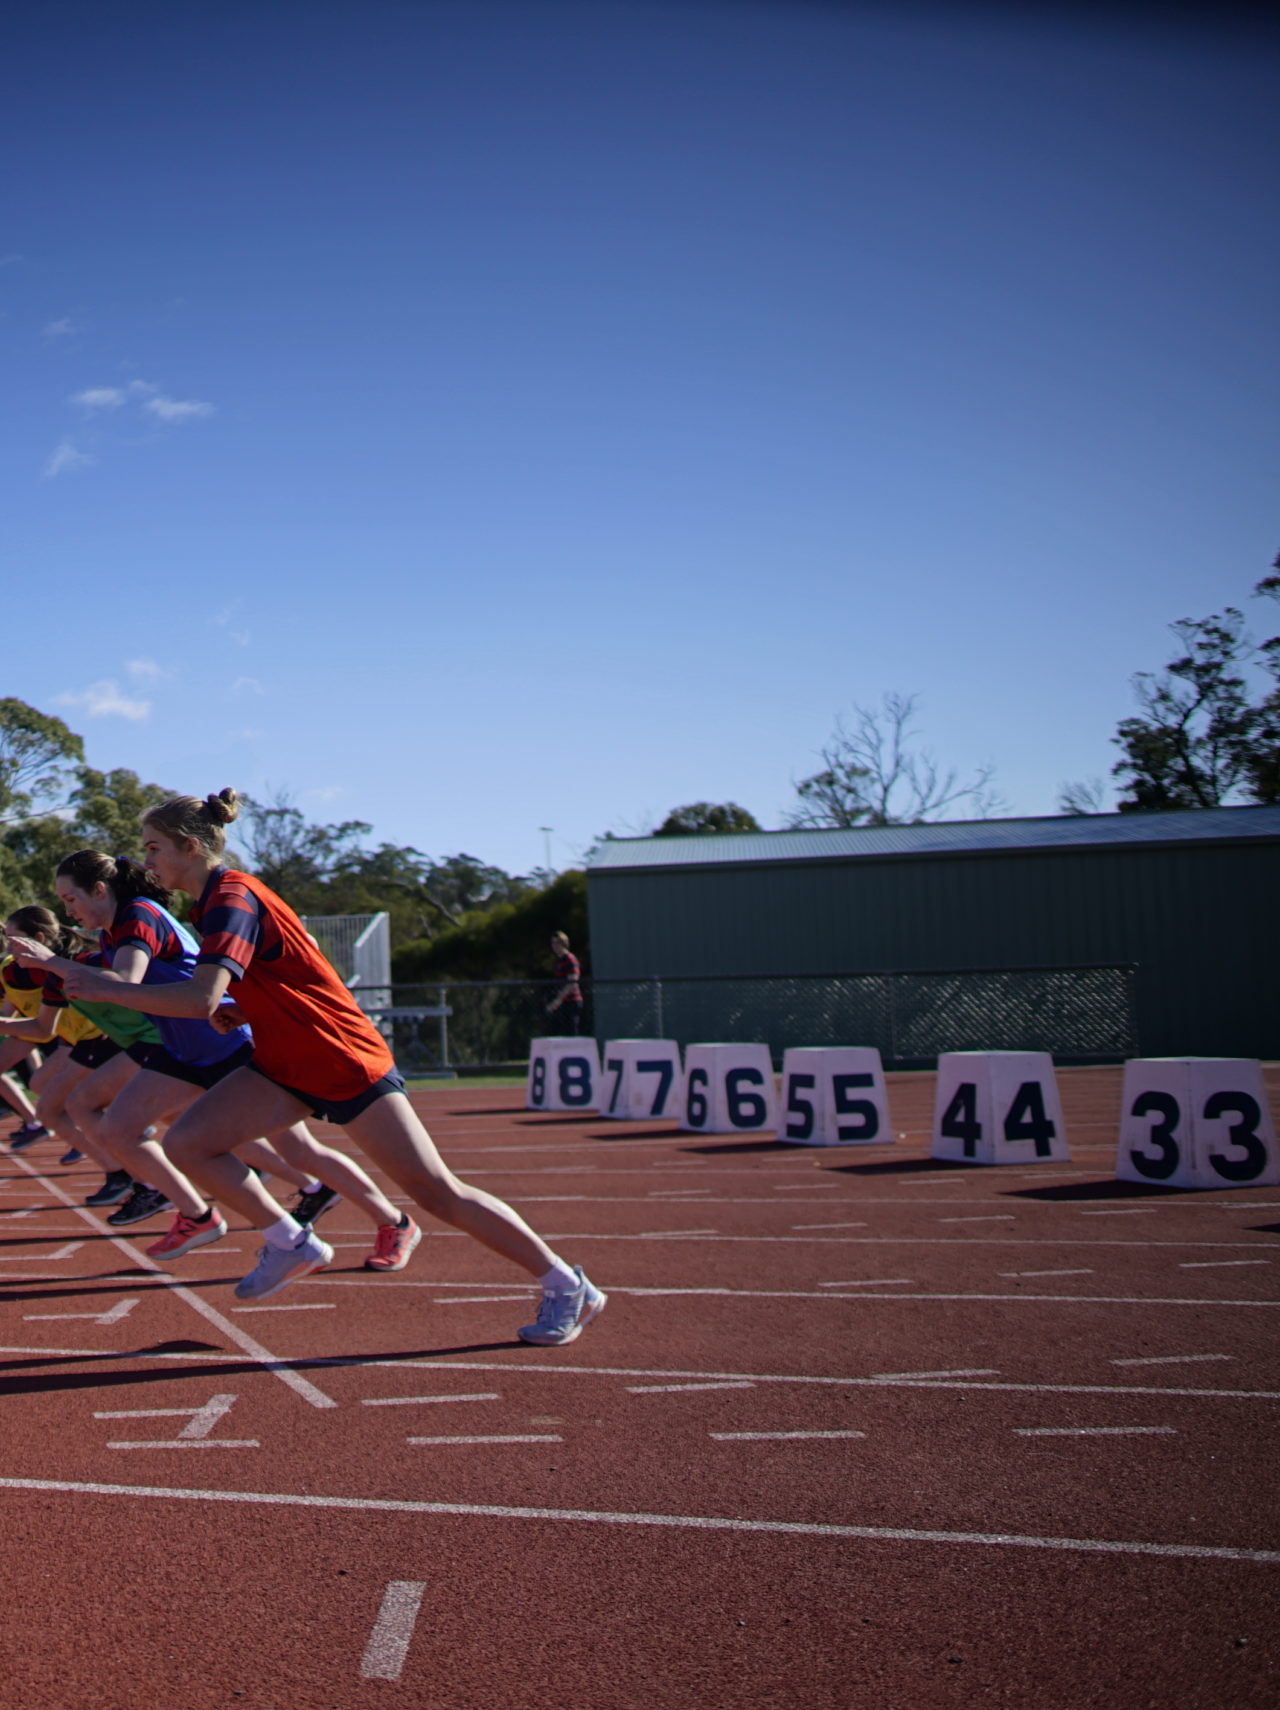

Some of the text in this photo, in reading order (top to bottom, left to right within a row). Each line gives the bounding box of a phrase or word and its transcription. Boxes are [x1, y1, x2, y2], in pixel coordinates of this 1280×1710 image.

[532, 1057, 546, 1106] 8
[558, 1057, 593, 1106] 8
[607, 1059, 624, 1114] 7
[636, 1060, 674, 1116] 7
[686, 1068, 708, 1128] 6
[725, 1067, 767, 1129] 6
[786, 1073, 815, 1139] 5
[832, 1073, 879, 1141] 5
[941, 1082, 982, 1157] 4
[1003, 1081, 1056, 1157] 4
[1130, 1090, 1180, 1180] 3
[1203, 1090, 1267, 1182] 3
